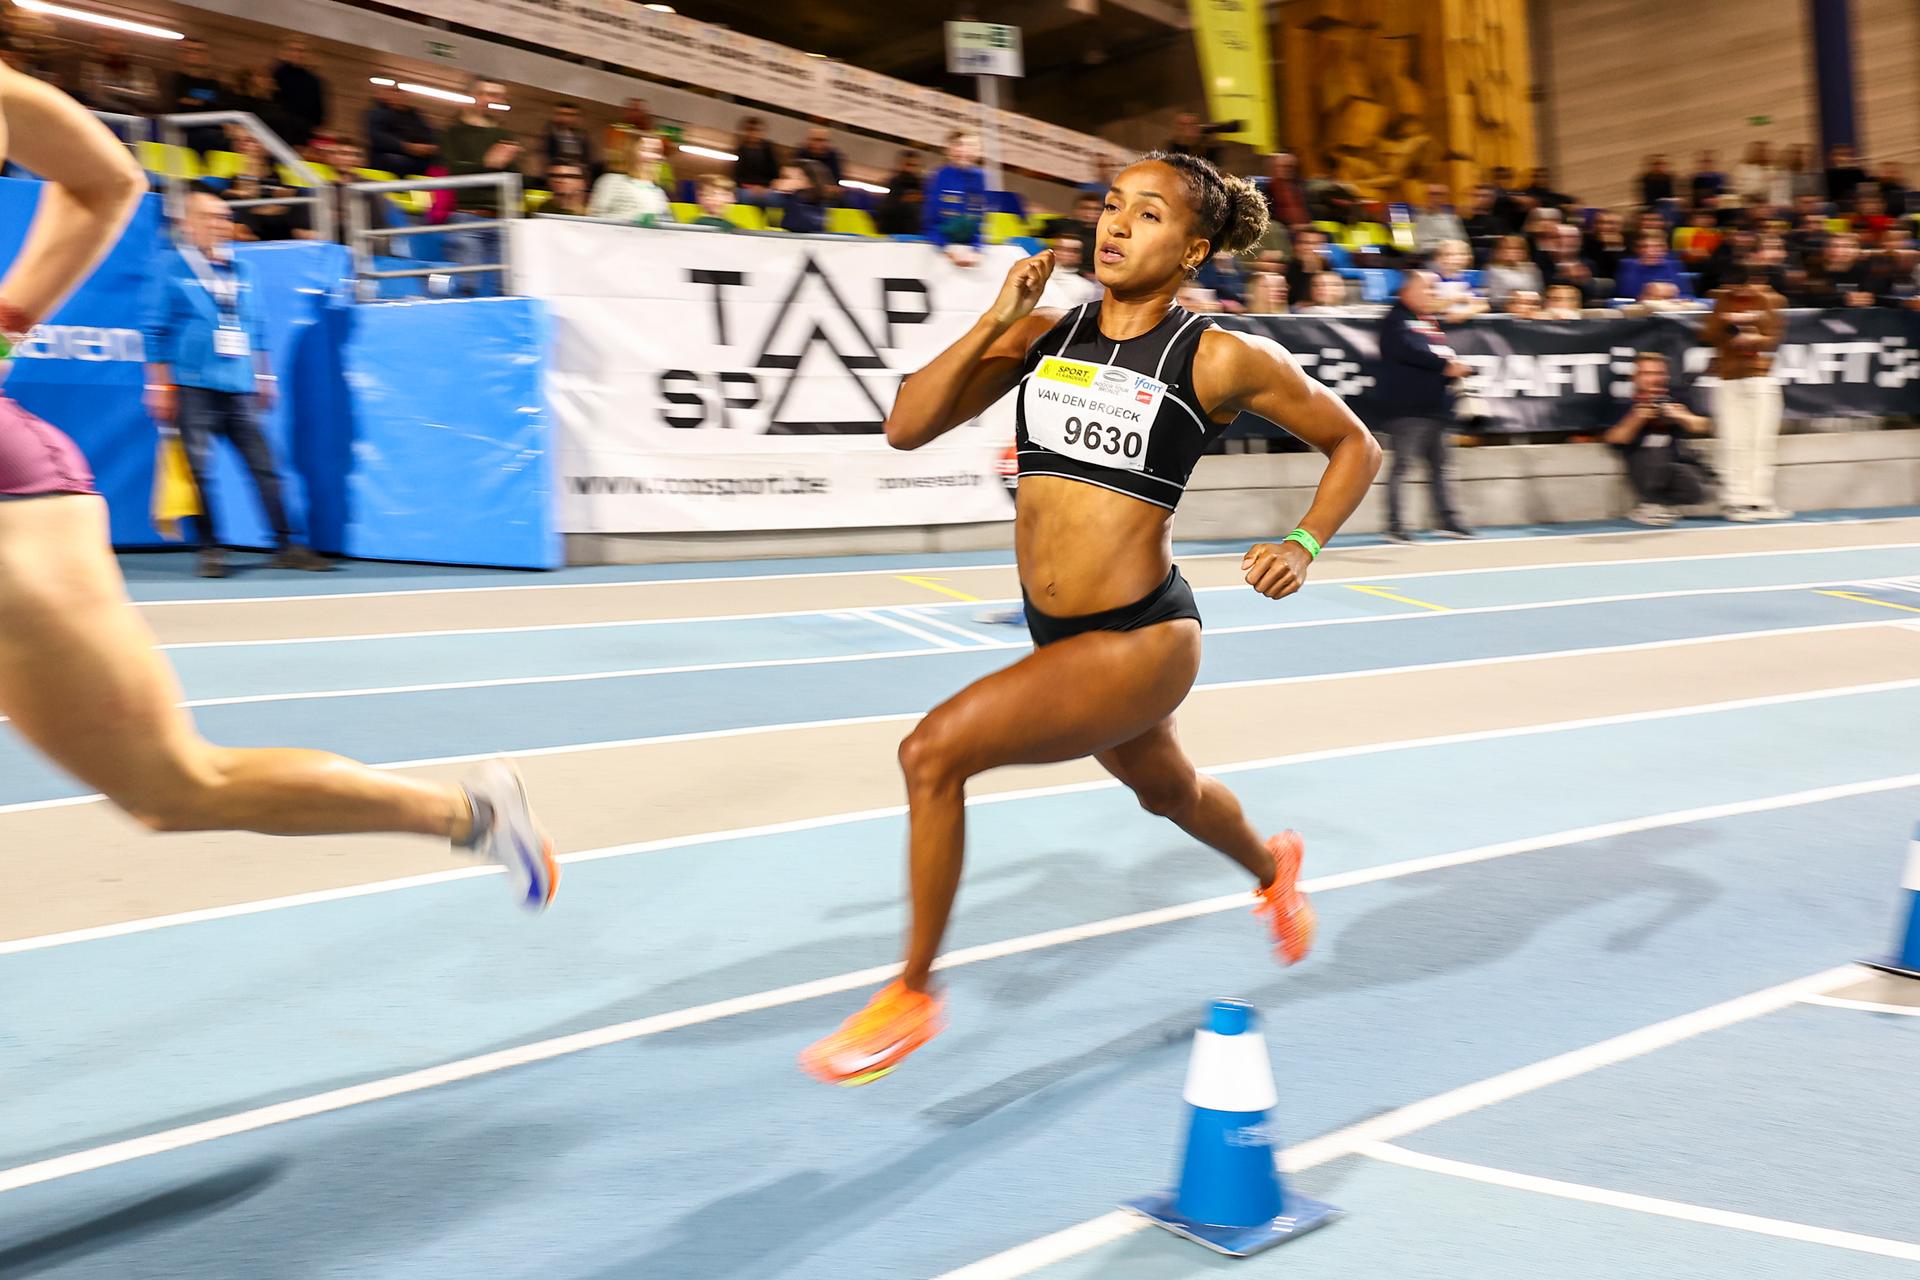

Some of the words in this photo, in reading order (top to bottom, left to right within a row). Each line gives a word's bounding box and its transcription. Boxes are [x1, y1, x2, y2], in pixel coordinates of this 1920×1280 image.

[1134, 376, 1162, 393] ifam
[1038, 388, 1060, 402] VAN
[1062, 394, 1086, 408] DEN
[1089, 402, 1141, 422] BROECK
[1063, 416, 1142, 458] 9630
